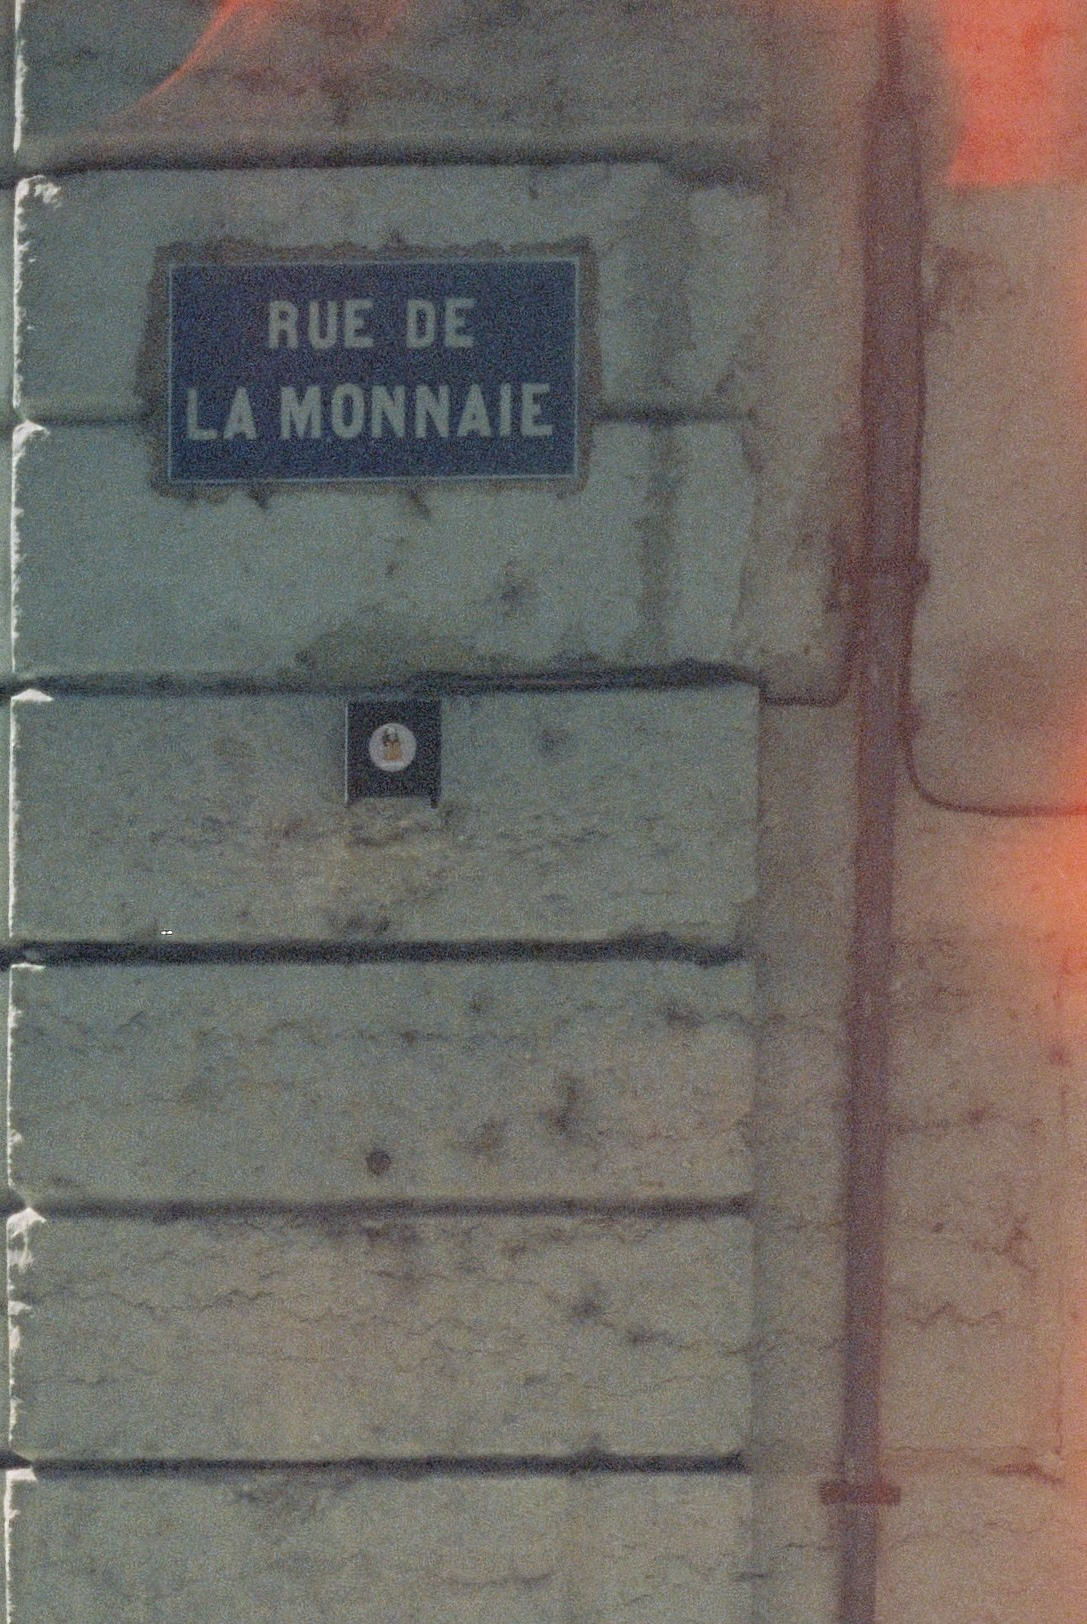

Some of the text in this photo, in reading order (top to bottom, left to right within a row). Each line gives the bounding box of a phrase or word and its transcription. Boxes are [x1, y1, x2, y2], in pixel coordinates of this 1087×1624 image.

[267, 299, 475, 351] RUE DE
[184, 382, 553, 441] LA MONNAIE
